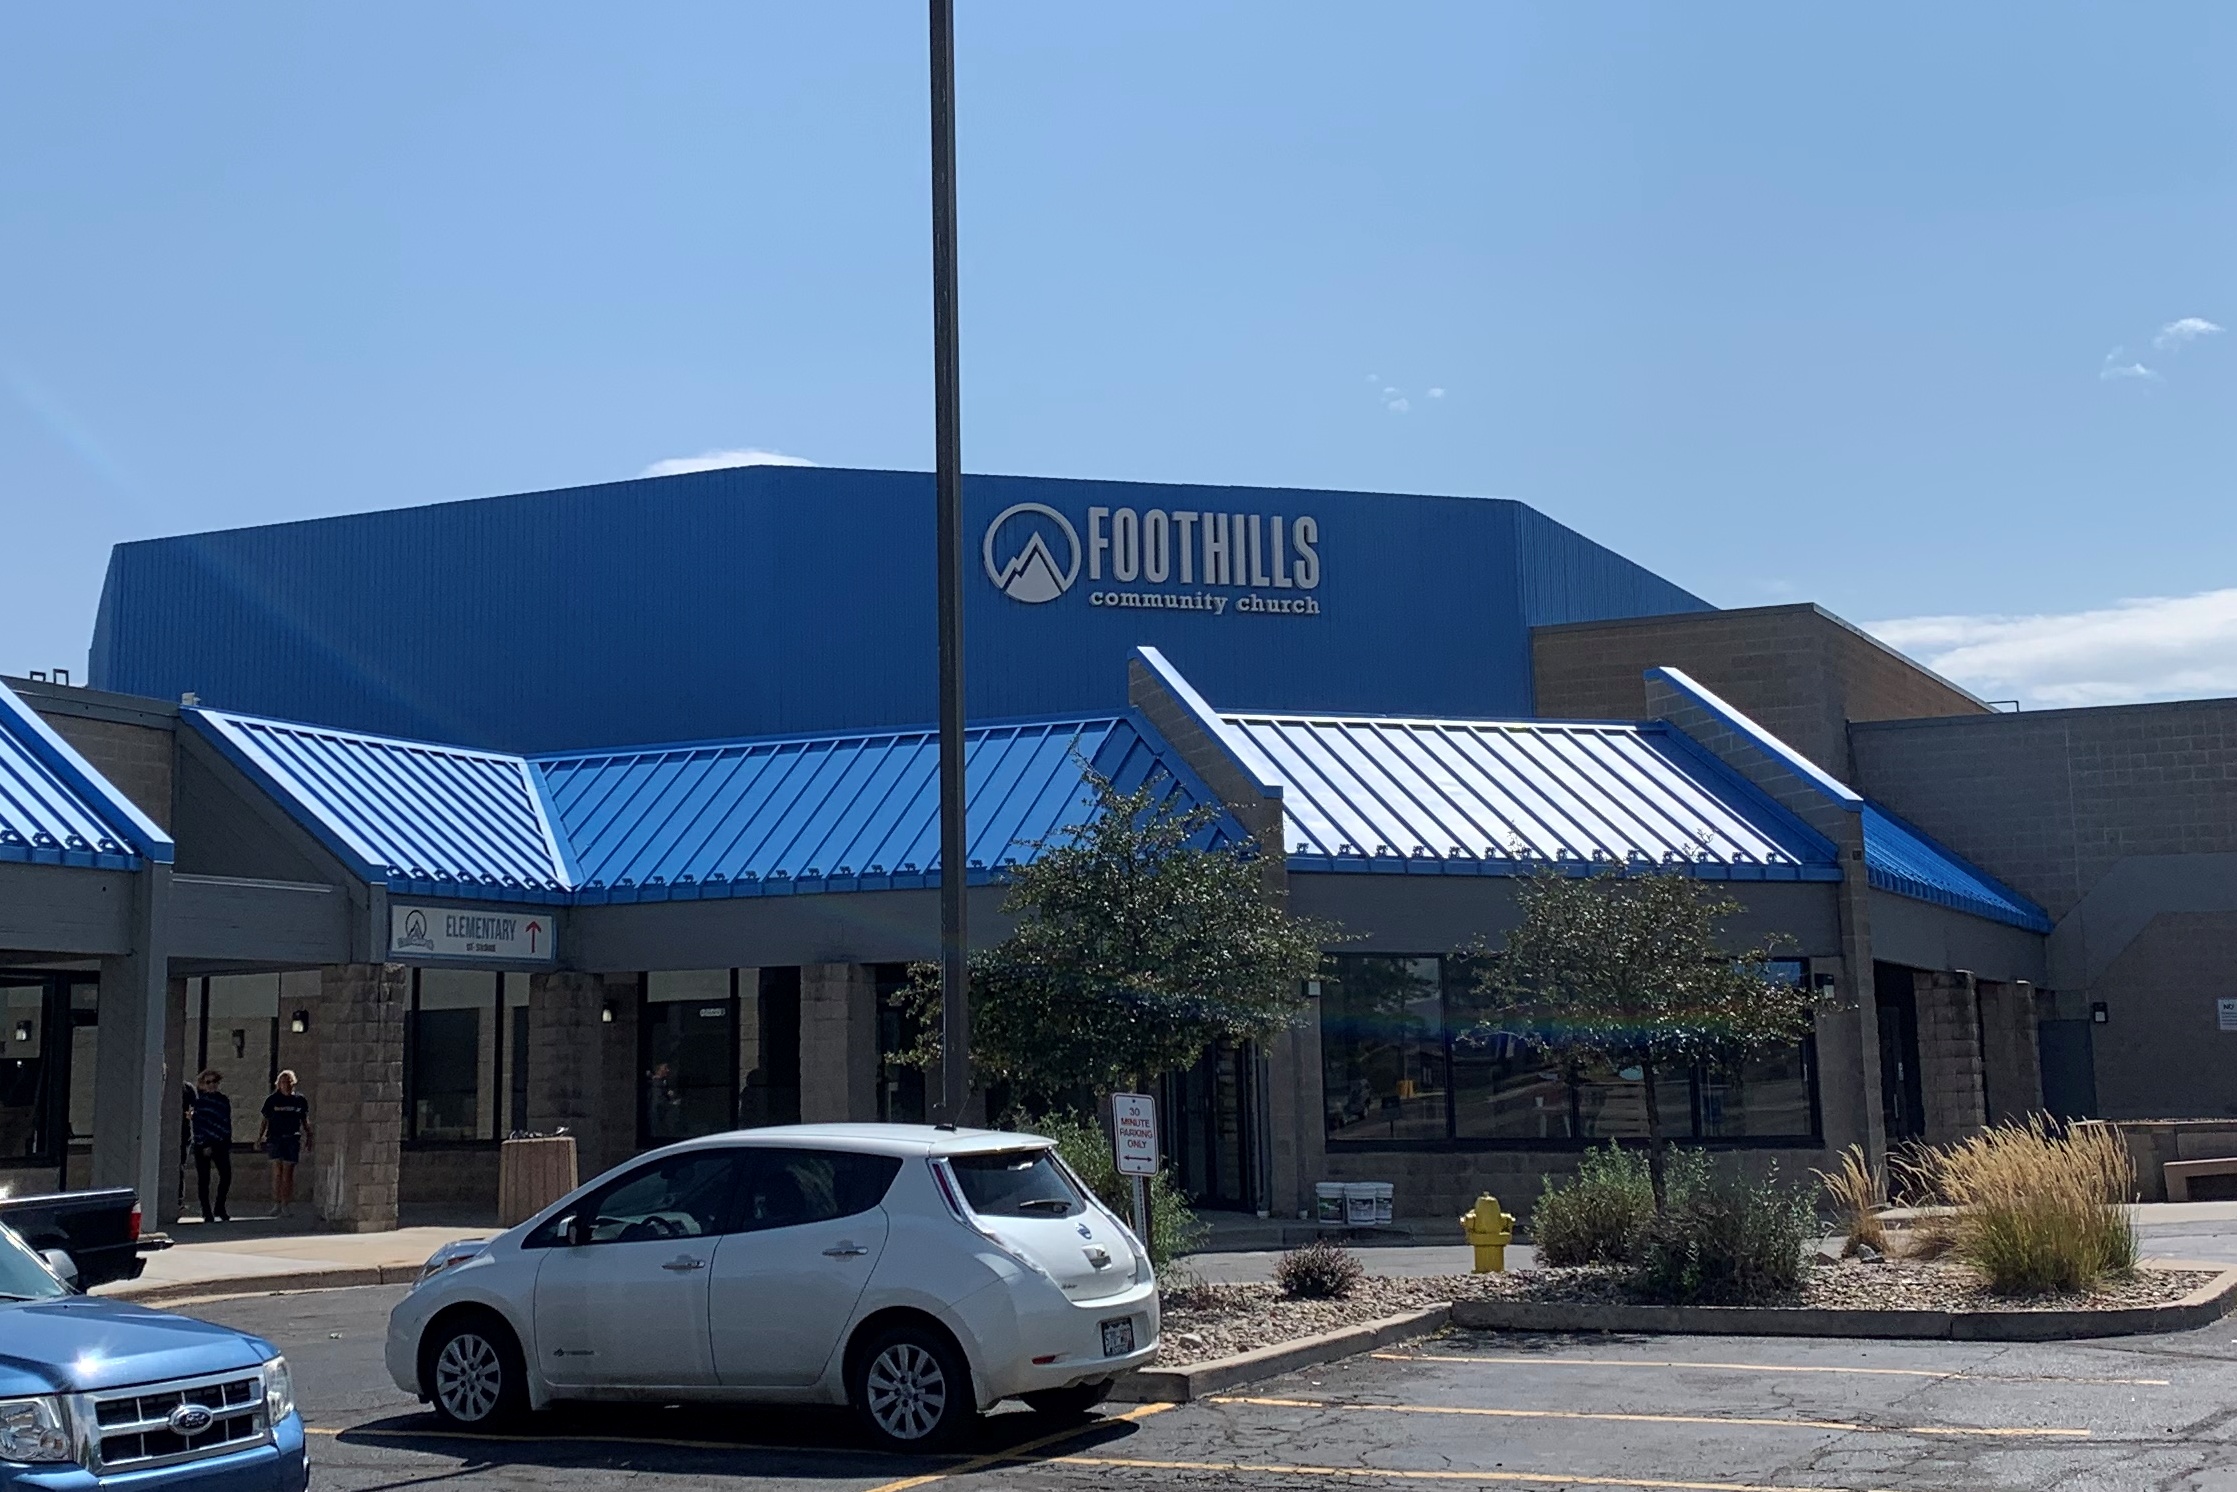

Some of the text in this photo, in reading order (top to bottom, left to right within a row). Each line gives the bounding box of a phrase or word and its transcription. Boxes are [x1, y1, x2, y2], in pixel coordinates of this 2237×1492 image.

[1087, 506, 1320, 589] FOOTHILLS
[1089, 591, 1320, 614] community church
[446, 915, 516, 941] ELEMENTARY
[1129, 1107, 1140, 1116] 30
[1121, 1117, 1150, 1127] MINUTE
[1120, 1128, 1153, 1138] PARKING
[1127, 1139, 1147, 1148] ONLY
